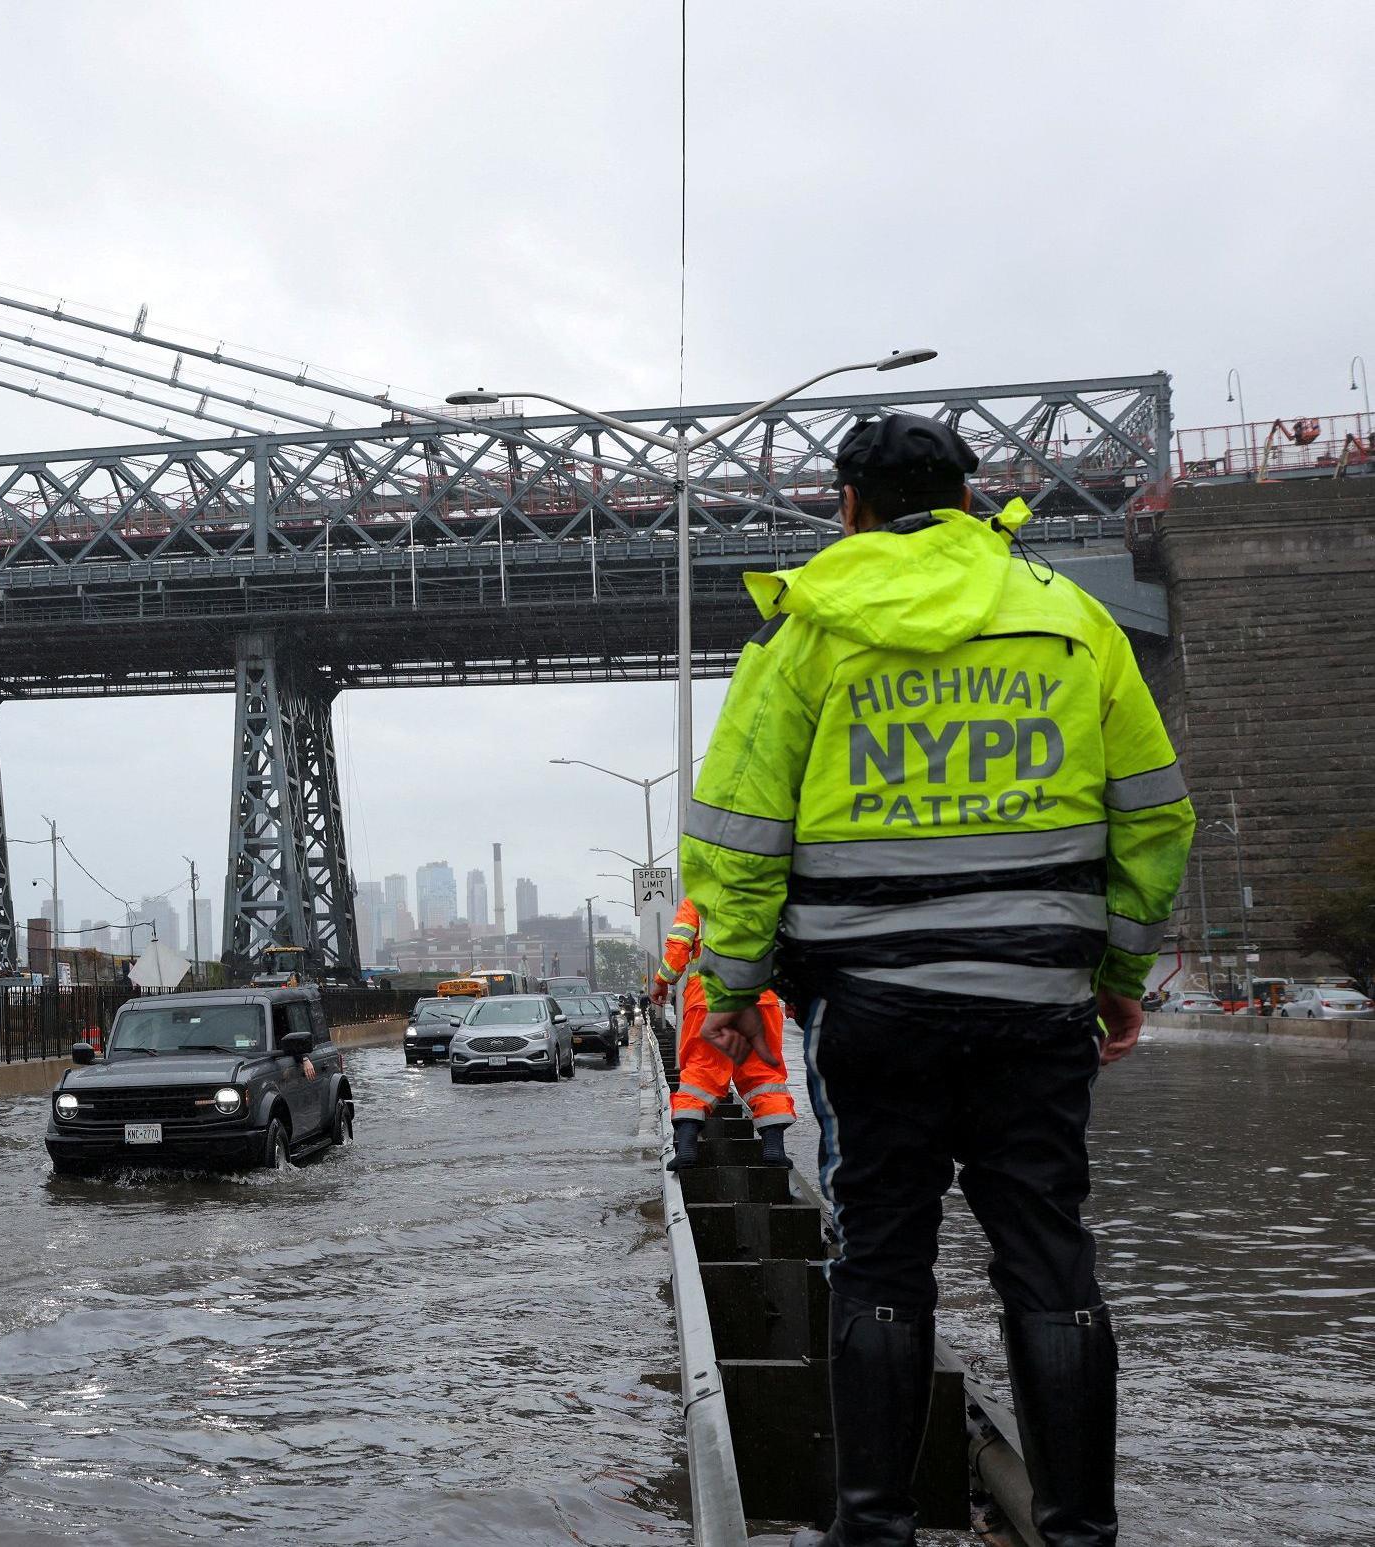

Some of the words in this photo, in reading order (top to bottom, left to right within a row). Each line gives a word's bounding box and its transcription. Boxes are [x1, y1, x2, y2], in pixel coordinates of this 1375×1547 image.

[848, 667, 1063, 719] HIGHWAY
[849, 717, 1065, 786] NYPD
[850, 785, 1058, 826] PATROL
[639, 871, 667, 879] SPEED
[642, 880, 664, 888] LIMIT
